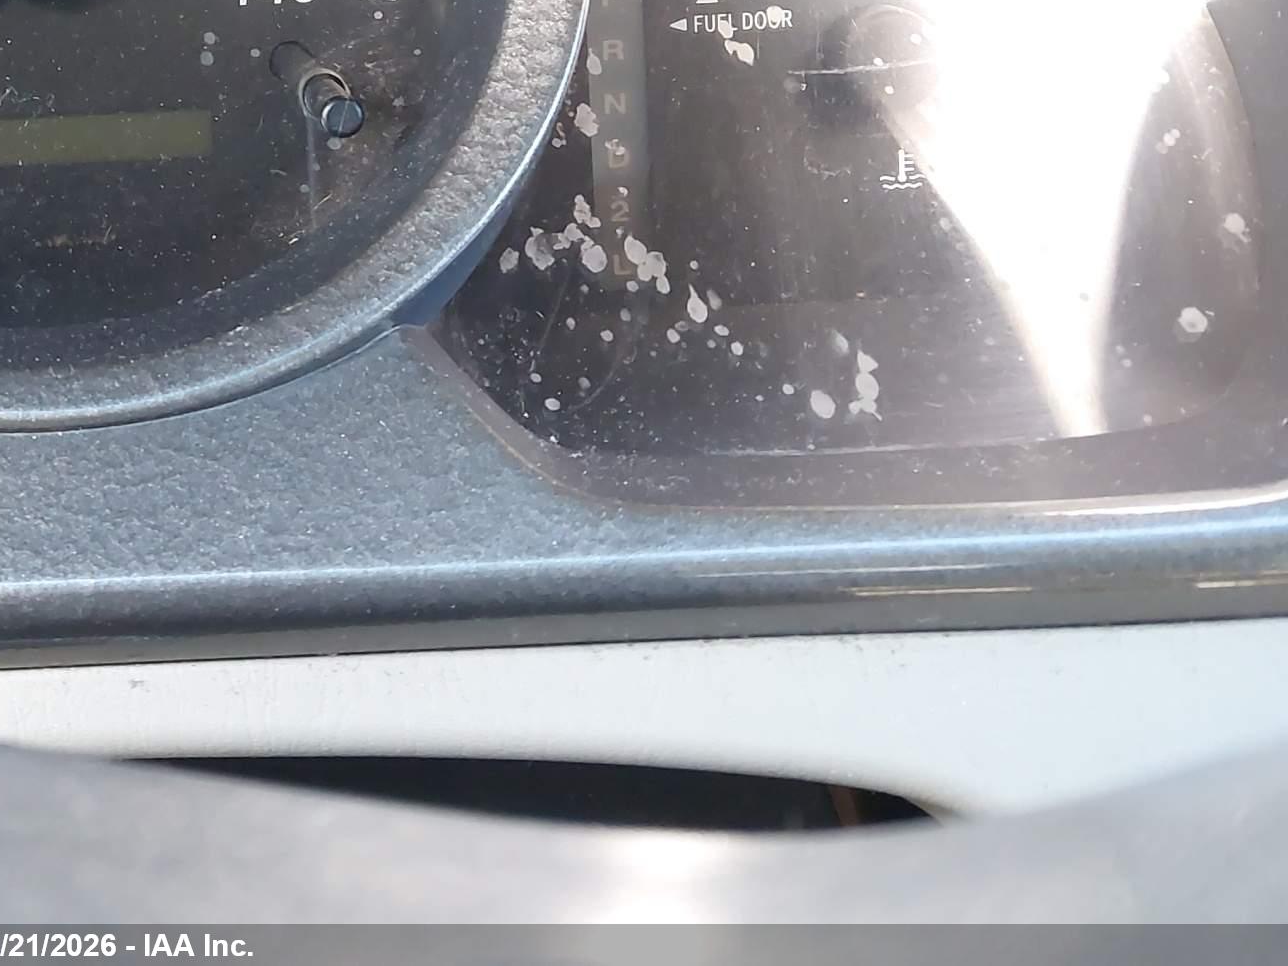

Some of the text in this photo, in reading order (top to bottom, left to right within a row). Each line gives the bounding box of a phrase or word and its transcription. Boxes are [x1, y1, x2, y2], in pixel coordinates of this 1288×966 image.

[694, 13, 738, 33] FUEL
[602, 39, 625, 60] R
[604, 92, 627, 114] N
[611, 200, 630, 222] 2
[614, 254, 632, 275] L
